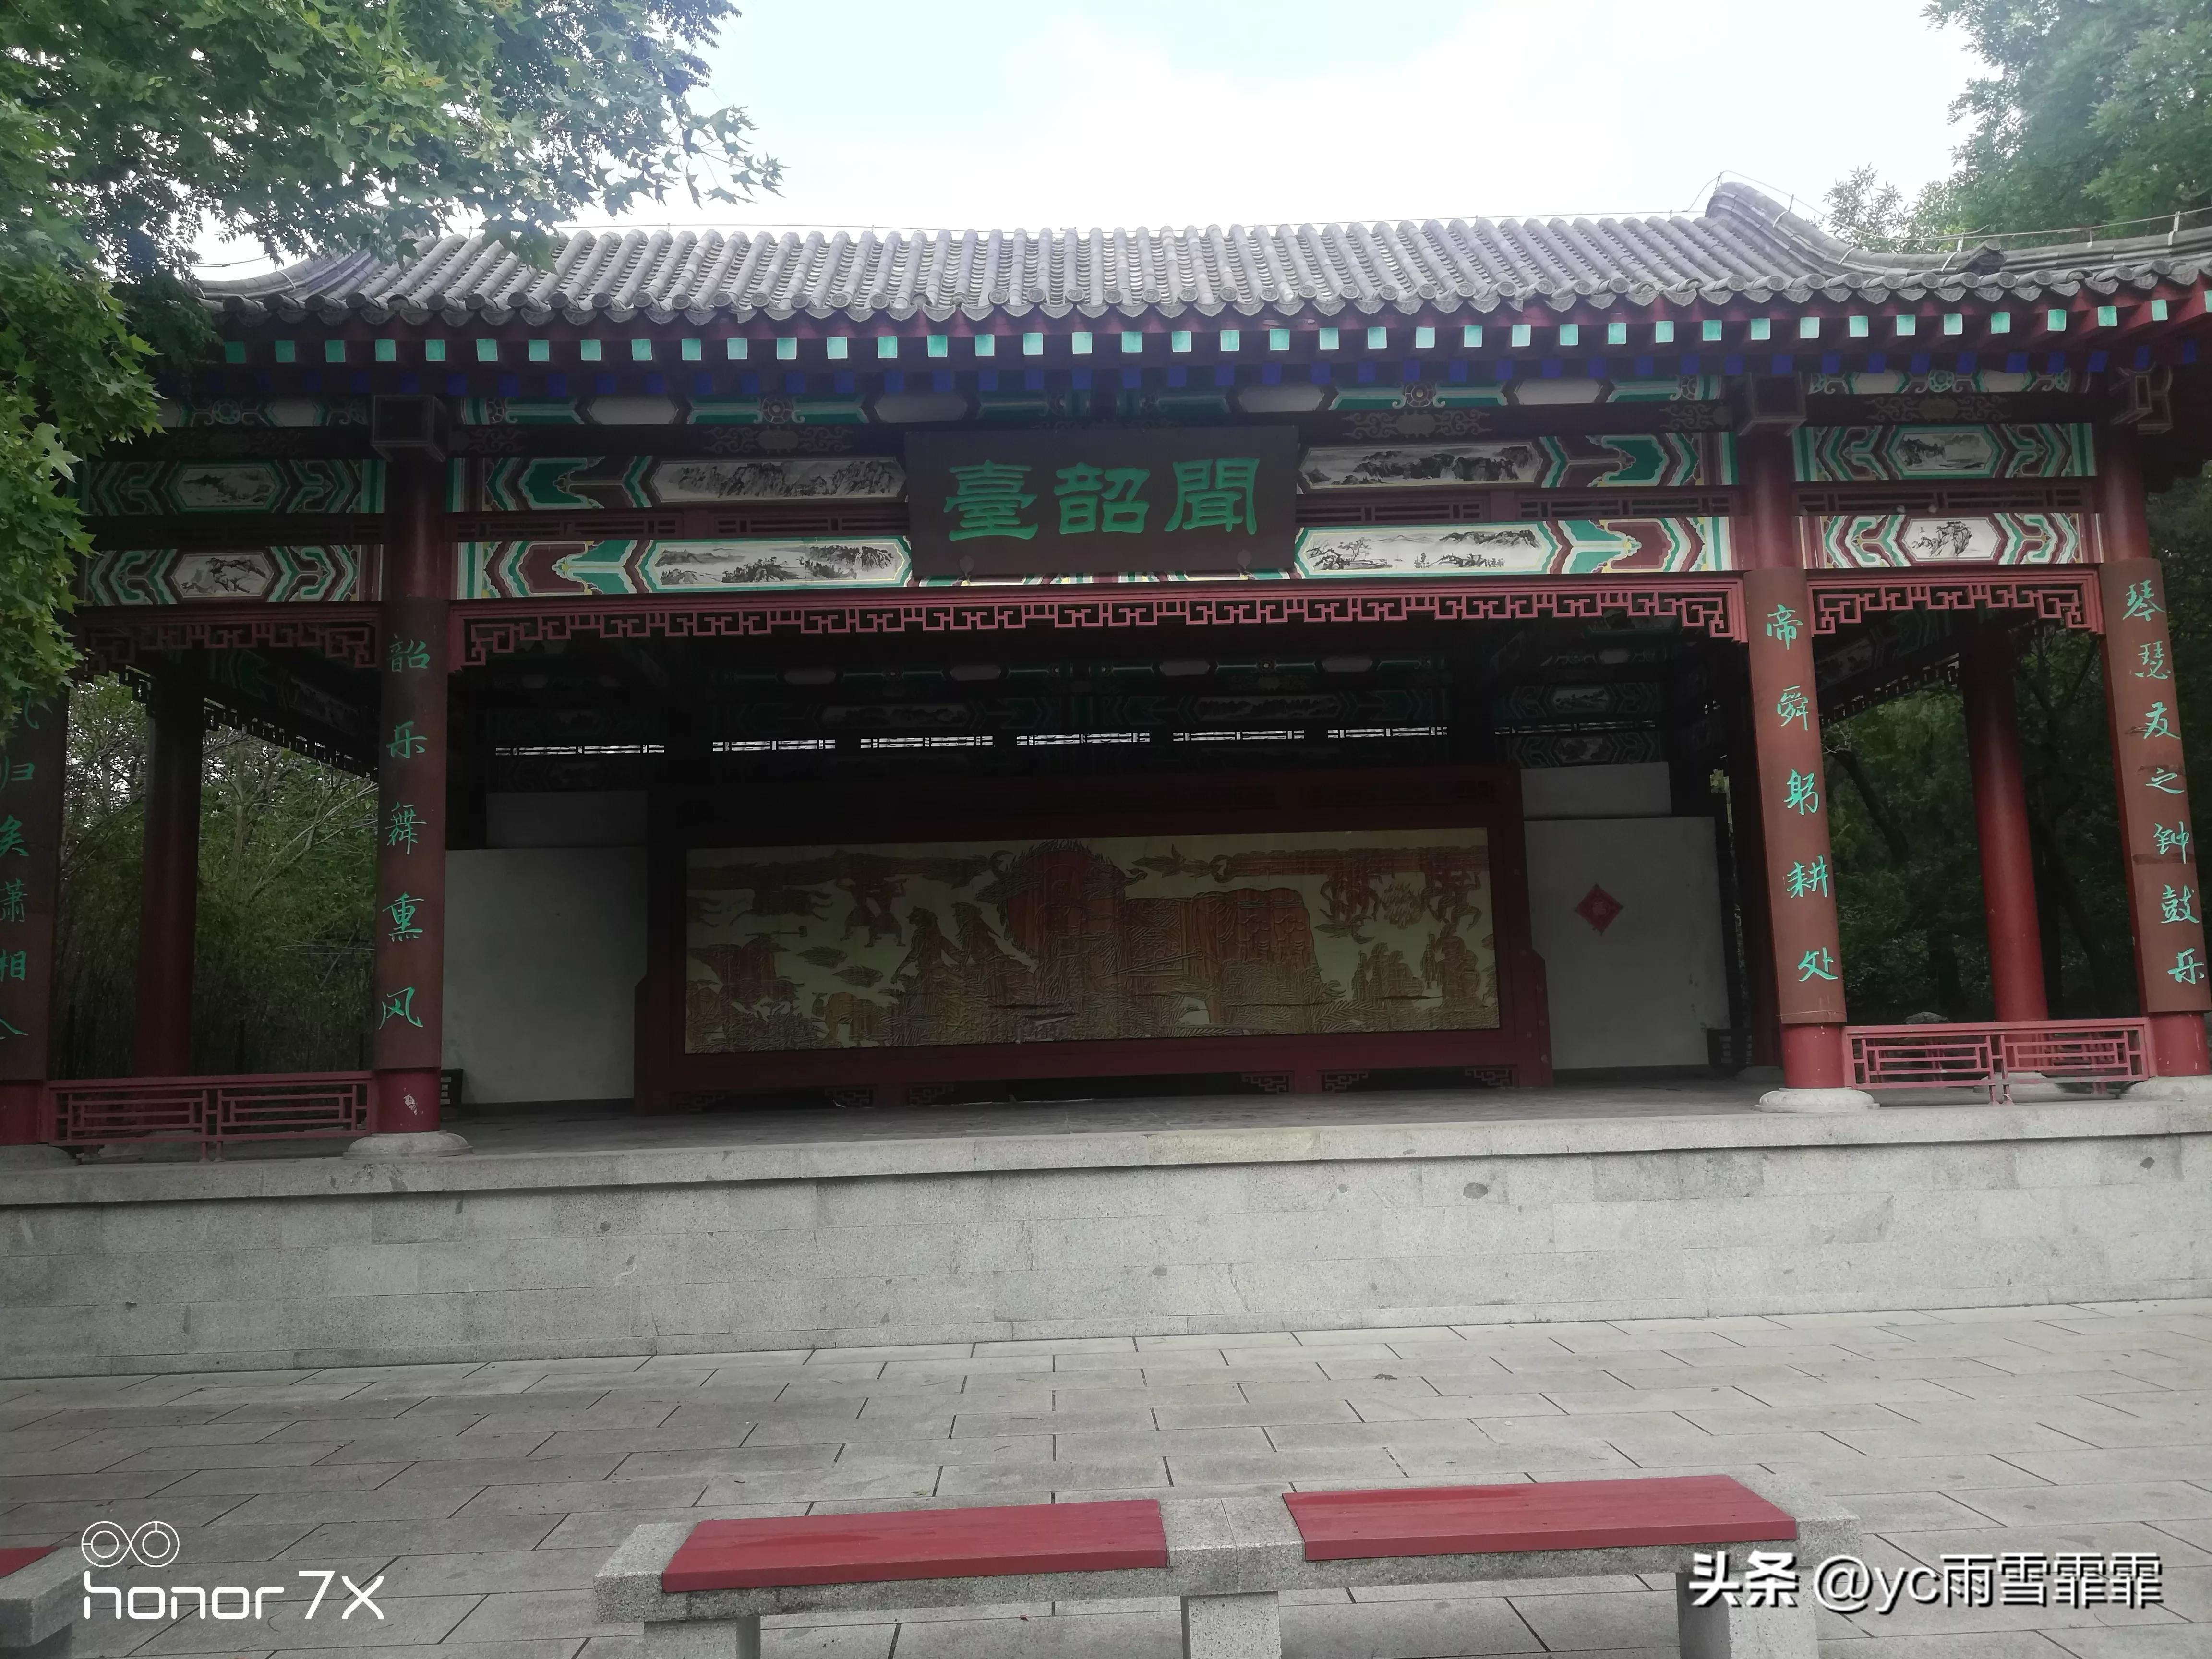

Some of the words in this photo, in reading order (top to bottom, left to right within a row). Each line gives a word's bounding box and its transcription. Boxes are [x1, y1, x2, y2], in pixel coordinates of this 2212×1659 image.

[1767, 604, 1839, 982] 帝舜躬耕处
[2122, 579, 2205, 985] 琴瑟友之钟鼓乐
